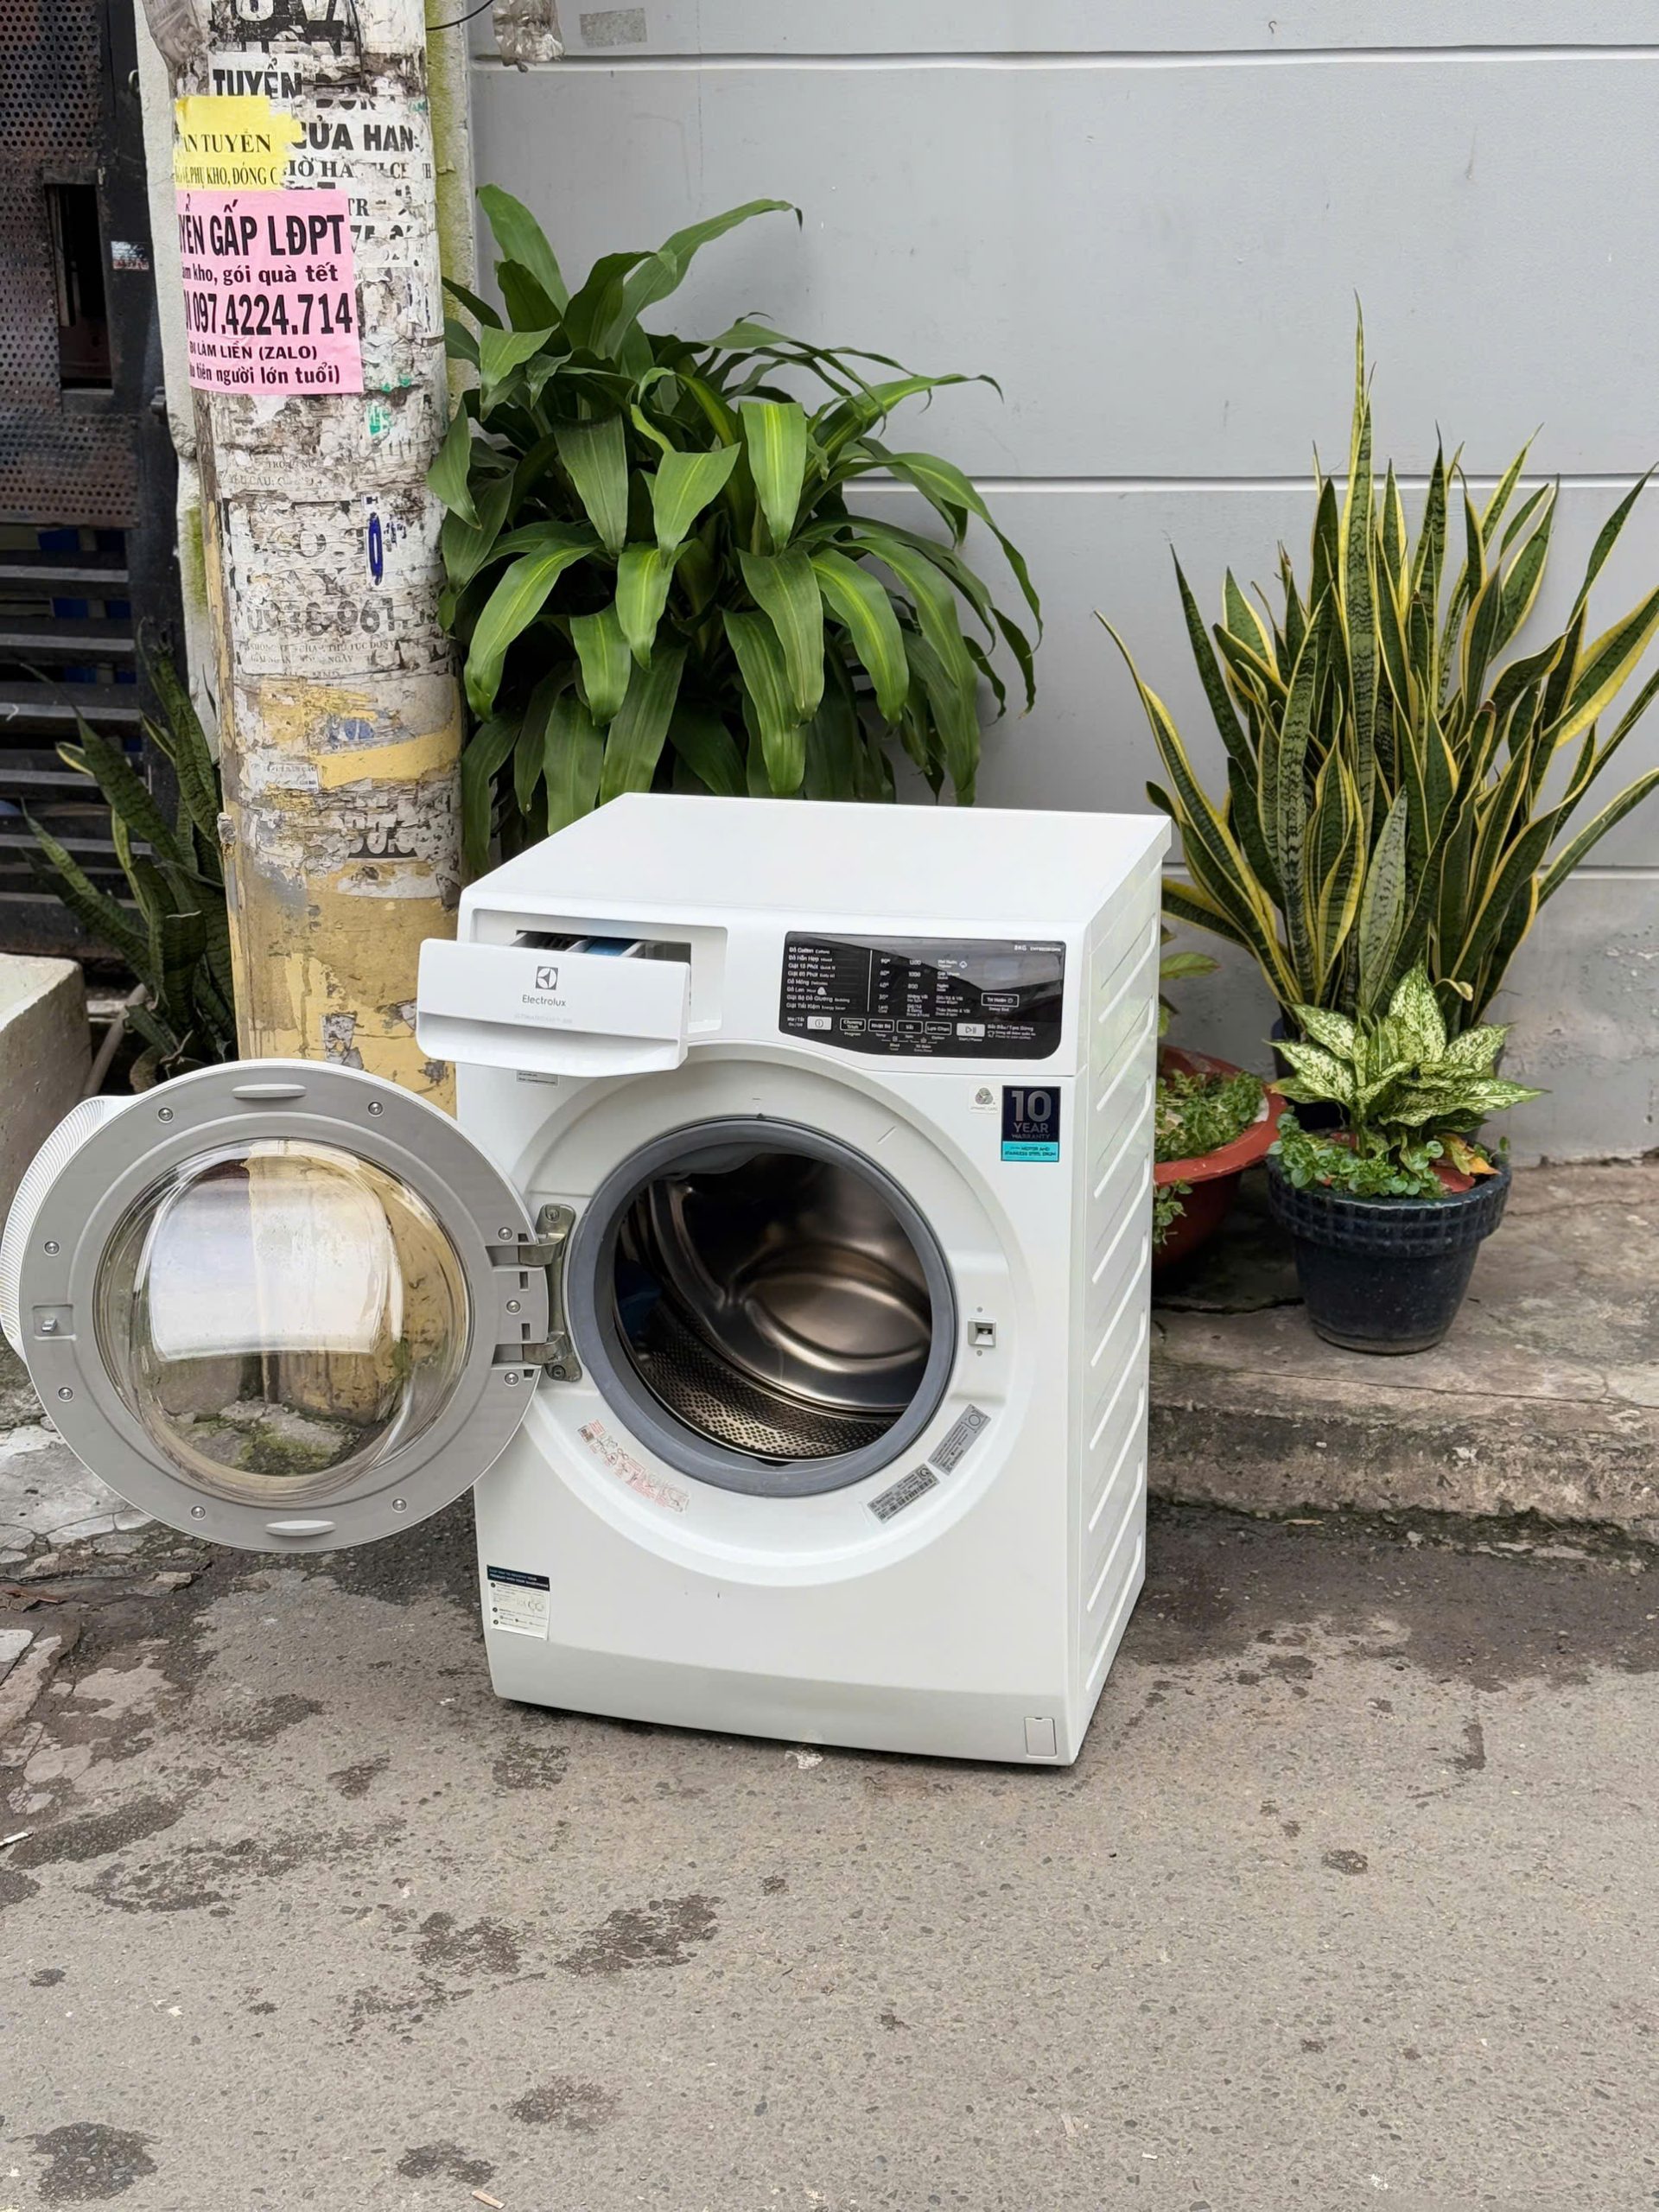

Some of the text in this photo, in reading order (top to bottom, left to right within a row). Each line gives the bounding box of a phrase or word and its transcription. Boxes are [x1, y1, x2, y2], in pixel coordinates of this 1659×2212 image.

[213, 58, 302, 99] TUYỂN
[200, 128, 271, 153] TUYỂN
[283, 156, 315, 177] IỜ
[178, 194, 206, 255] YỂN
[210, 199, 257, 257] GẤP
[268, 214, 345, 256] LĐPT
[194, 263, 218, 286] kho,
[223, 264, 251, 286] gói
[259, 264, 297, 286] quà
[306, 262, 339, 282] tết
[193, 292, 353, 335] 097.4224.714
[198, 340, 217, 357] LÀM
[220, 340, 252, 359] LIỀN
[259, 346, 317, 360] (ZALO)
[216, 365, 254, 385] người
[261, 366, 289, 385] lớn
[296, 362, 340, 385] tuổi)
[522, 995, 567, 1007] Electrolux
[1011, 1090, 1052, 1122] 10
[1014, 1122, 1049, 1134] YEAR
